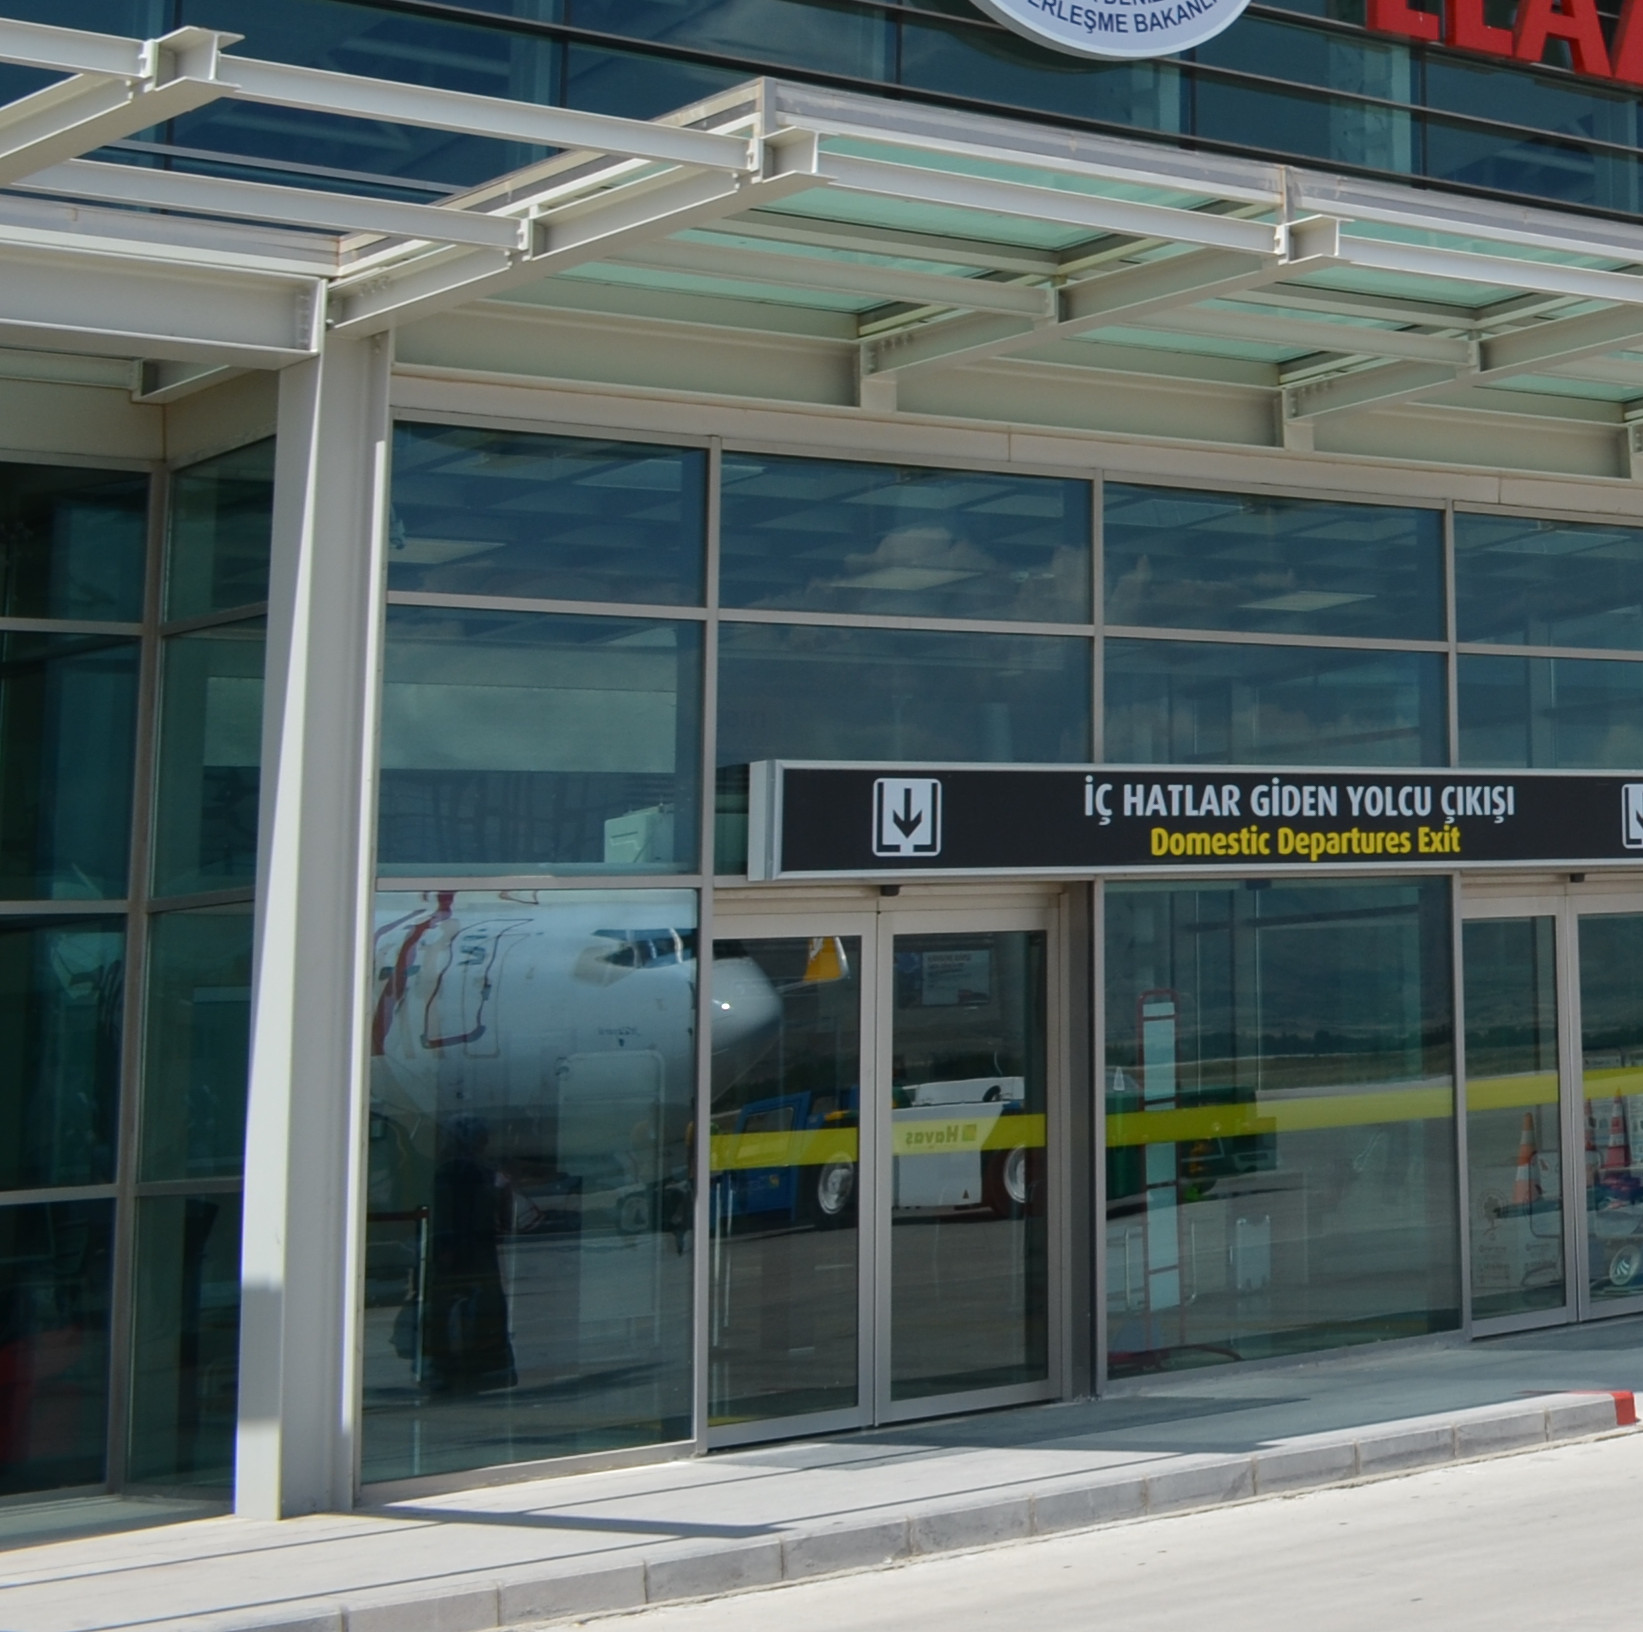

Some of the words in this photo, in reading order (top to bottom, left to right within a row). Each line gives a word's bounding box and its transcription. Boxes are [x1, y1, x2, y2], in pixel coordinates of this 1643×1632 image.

[1085, 775, 1113, 825] İÇ
[1123, 784, 1241, 817] HATLAR
[1250, 777, 1338, 817] GİDEN
[1346, 785, 1432, 817] YOLCU
[1440, 785, 1515, 824] ÇIKIŞI
[1151, 825, 1271, 856] Domestic
[1277, 826, 1411, 861] Departures
[1417, 825, 1460, 853] Exit
